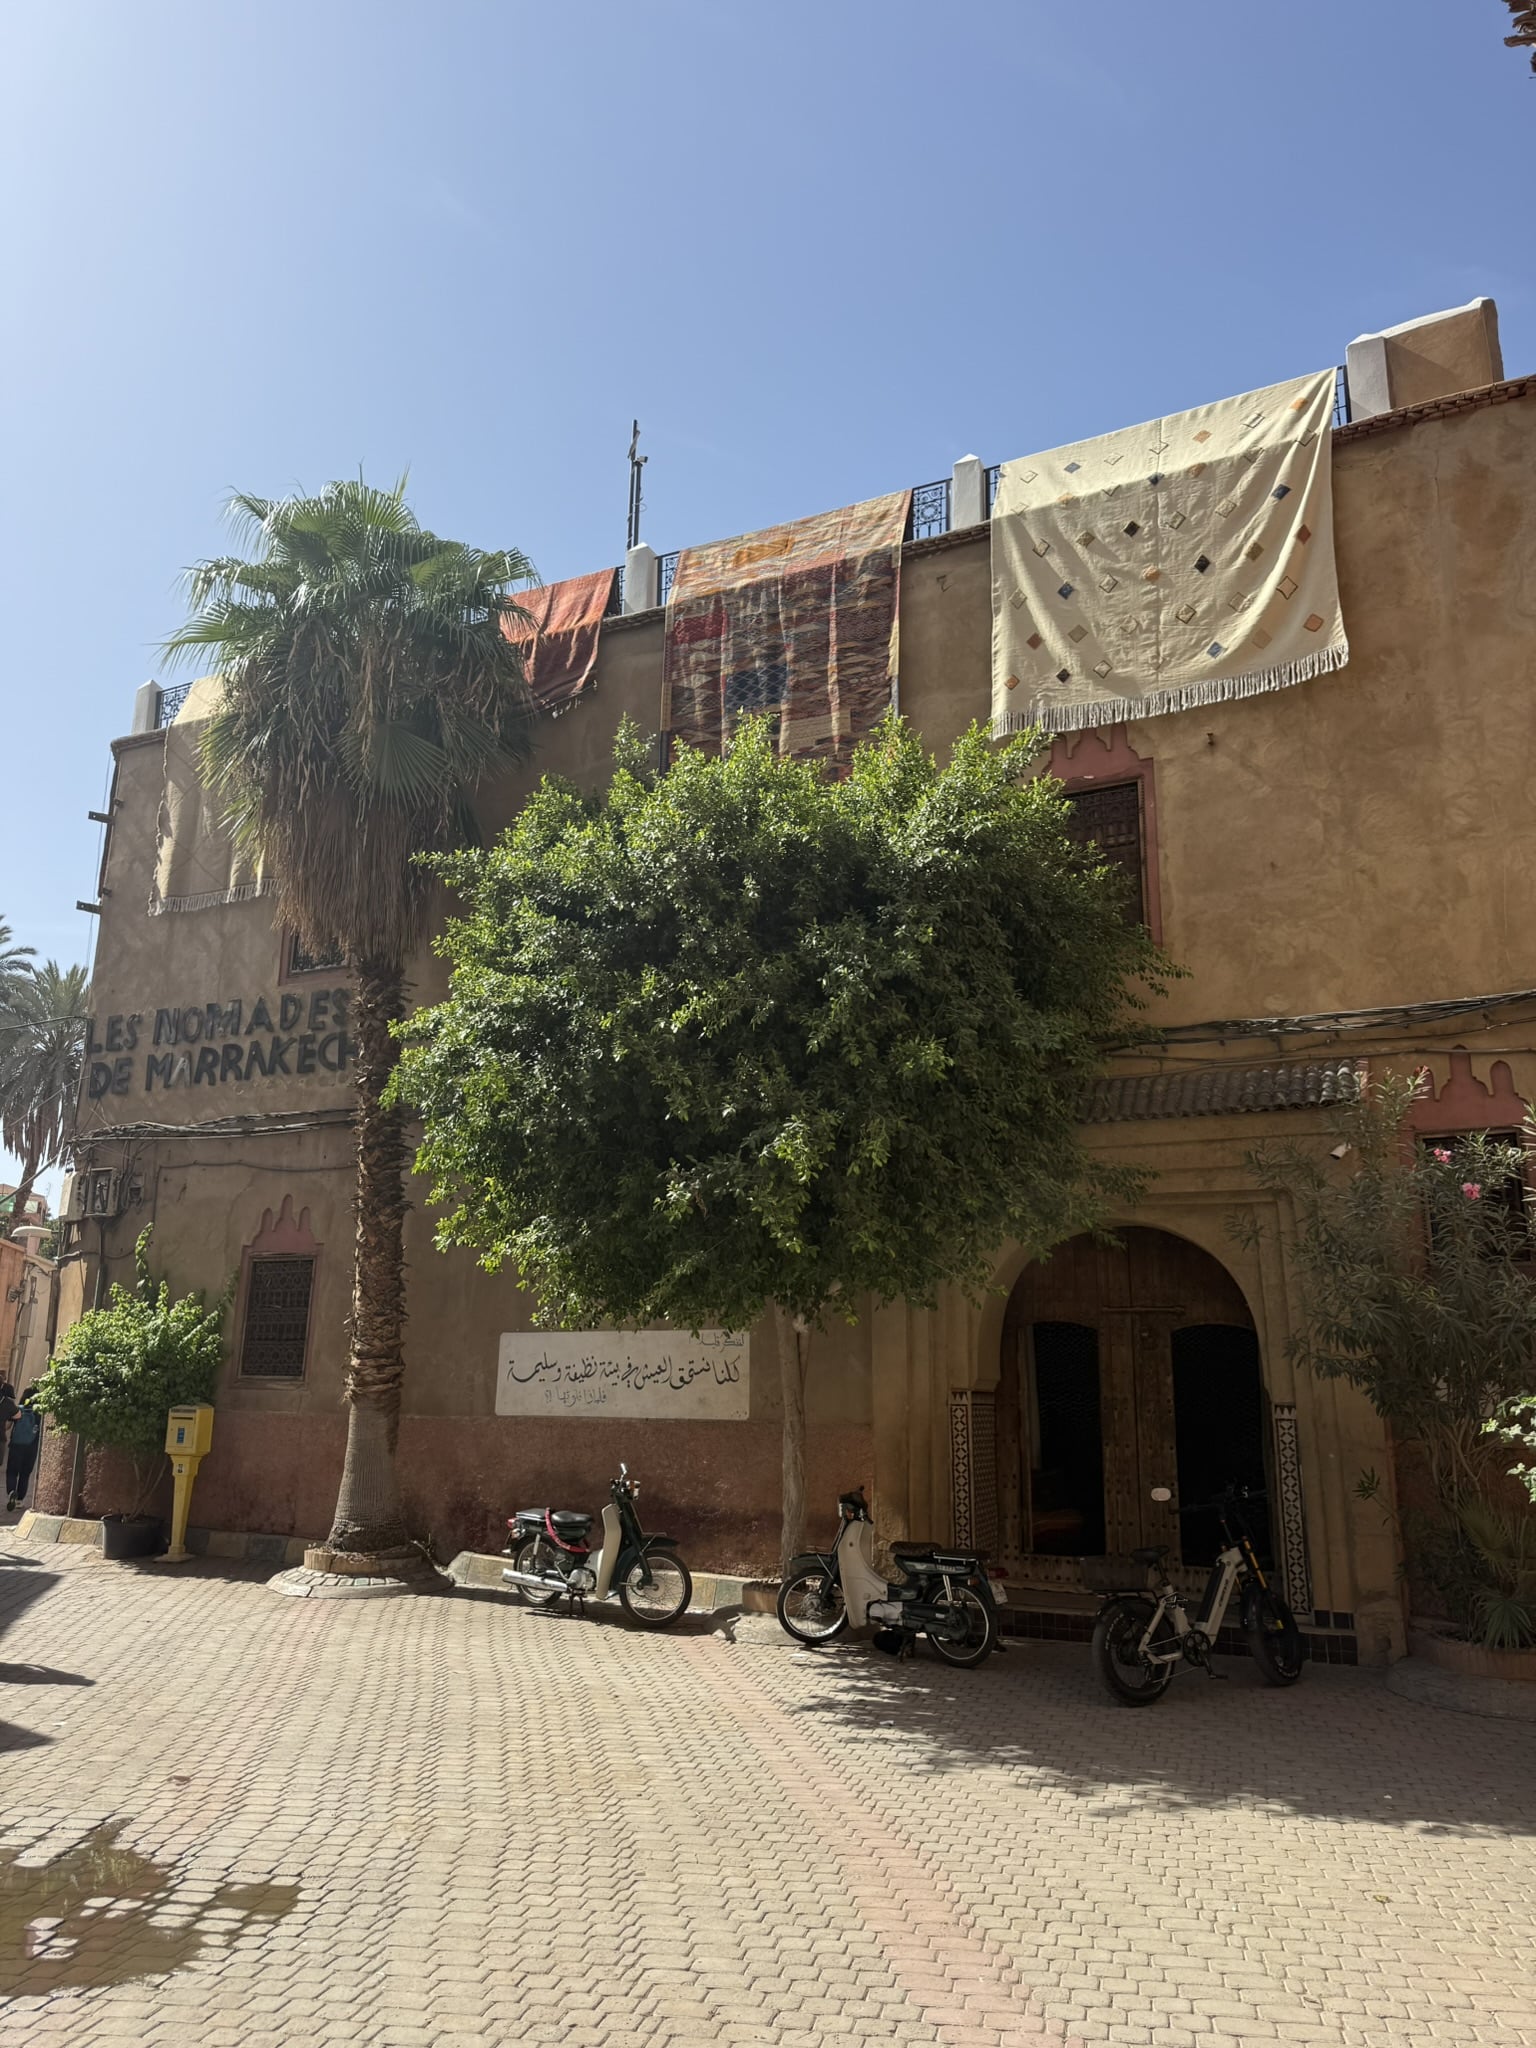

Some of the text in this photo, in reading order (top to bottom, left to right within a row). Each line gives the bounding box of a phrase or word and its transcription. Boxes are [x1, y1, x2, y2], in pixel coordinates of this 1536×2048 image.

[87, 988, 350, 1053] LES NOMADES
[88, 1057, 133, 1099] DE
[563, 1355, 598, 1384] نظيفة
[600, 1361, 620, 1386] بيئة
[622, 1355, 639, 1388] في
[634, 1354, 672, 1390] العيش
[669, 1357, 711, 1390] نستحق
[712, 1354, 741, 1385] كلنا
